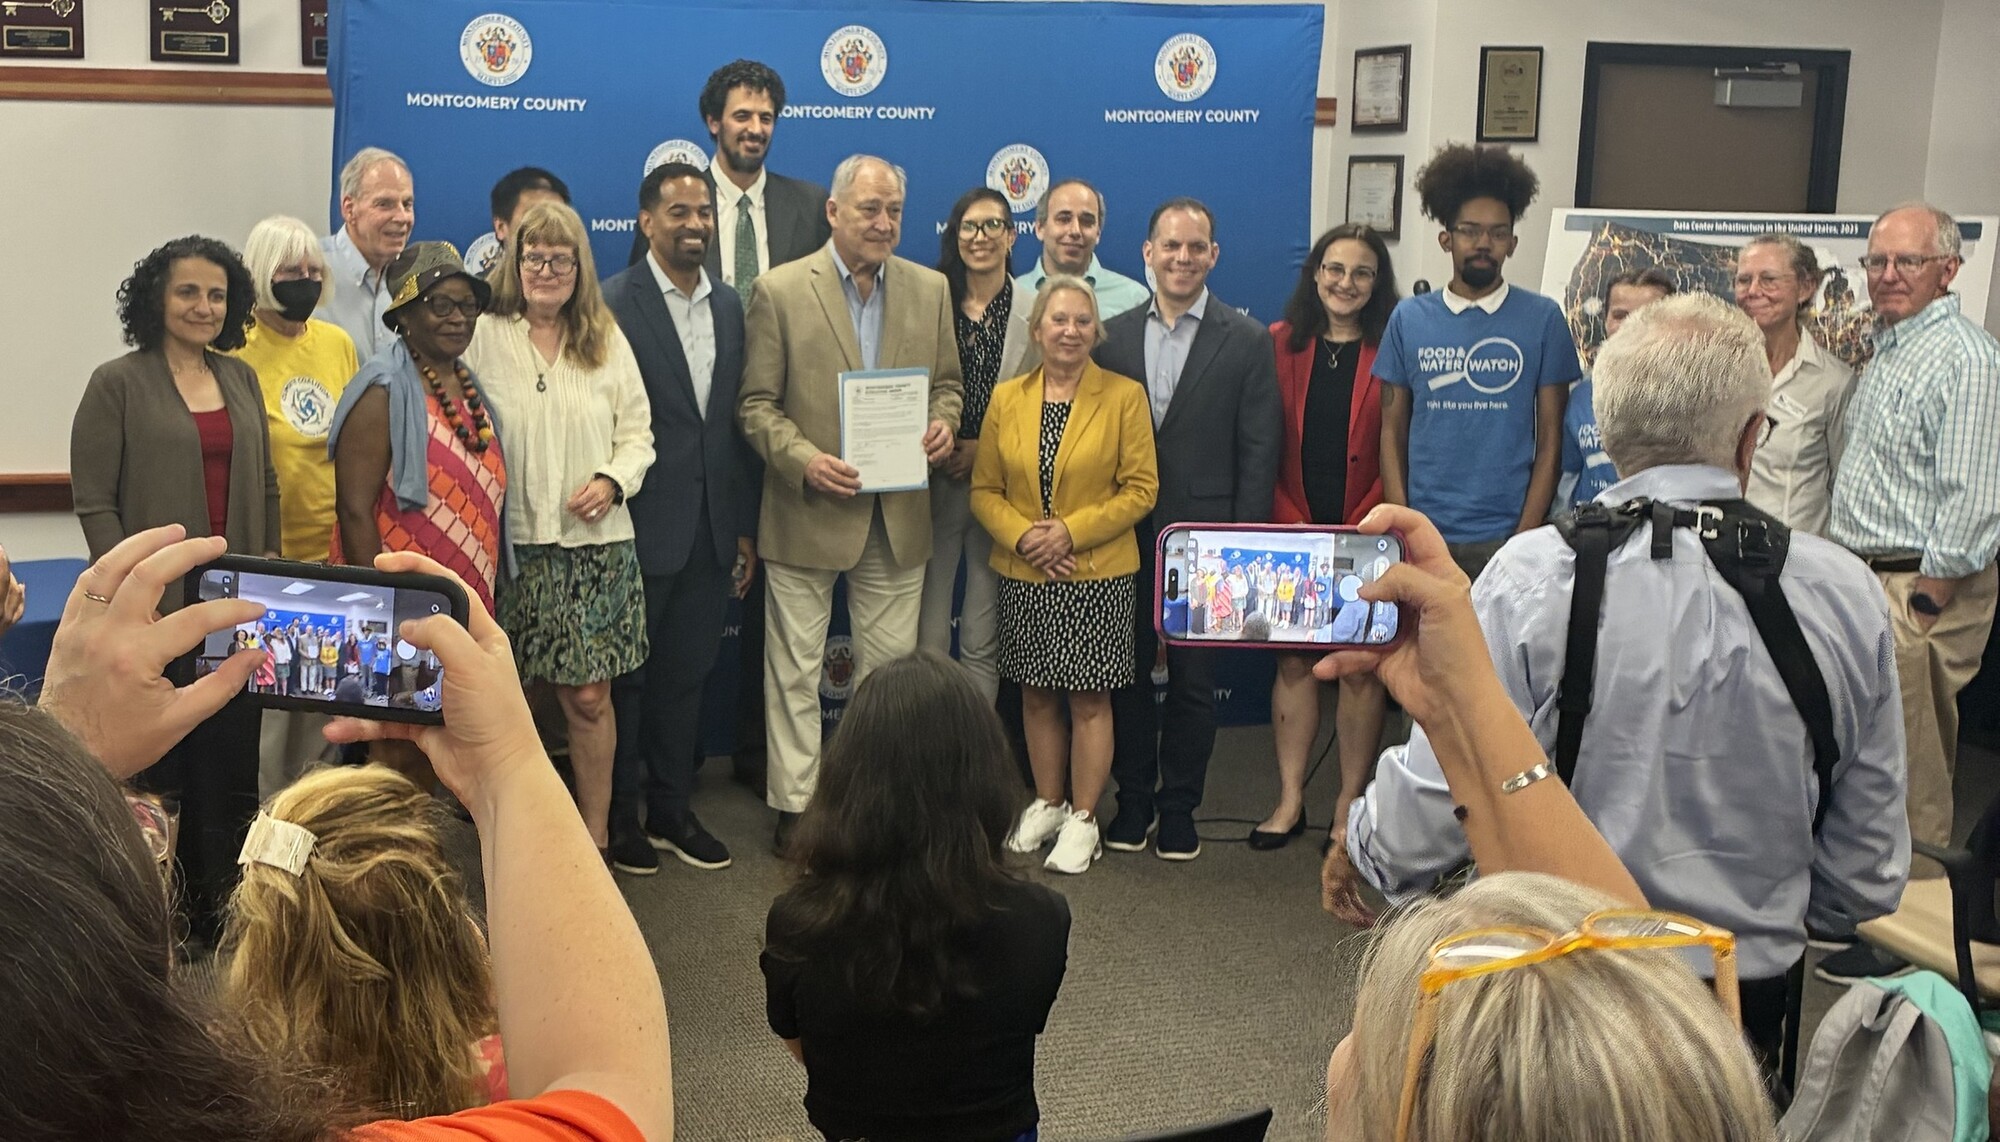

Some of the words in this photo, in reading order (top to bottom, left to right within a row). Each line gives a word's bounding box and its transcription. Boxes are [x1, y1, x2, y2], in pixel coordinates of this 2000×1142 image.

[406, 93, 520, 110] MONTGOMERY
[523, 97, 587, 112] COUNTY
[778, 105, 874, 119] ONTGOMERY
[876, 106, 936, 119] COUNTY
[1104, 109, 1203, 123] MONTGOMERY
[1205, 109, 1260, 123] COUNTY
[1673, 220, 1690, 232] Data
[1691, 220, 1714, 232] Center
[1715, 221, 1765, 233] Infrastructure
[1765, 222, 1773, 233] in
[1774, 222, 1787, 233] the
[1788, 222, 1813, 234] United
[1419, 358, 1463, 372] WATER
[1469, 358, 1519, 373] WATCH
